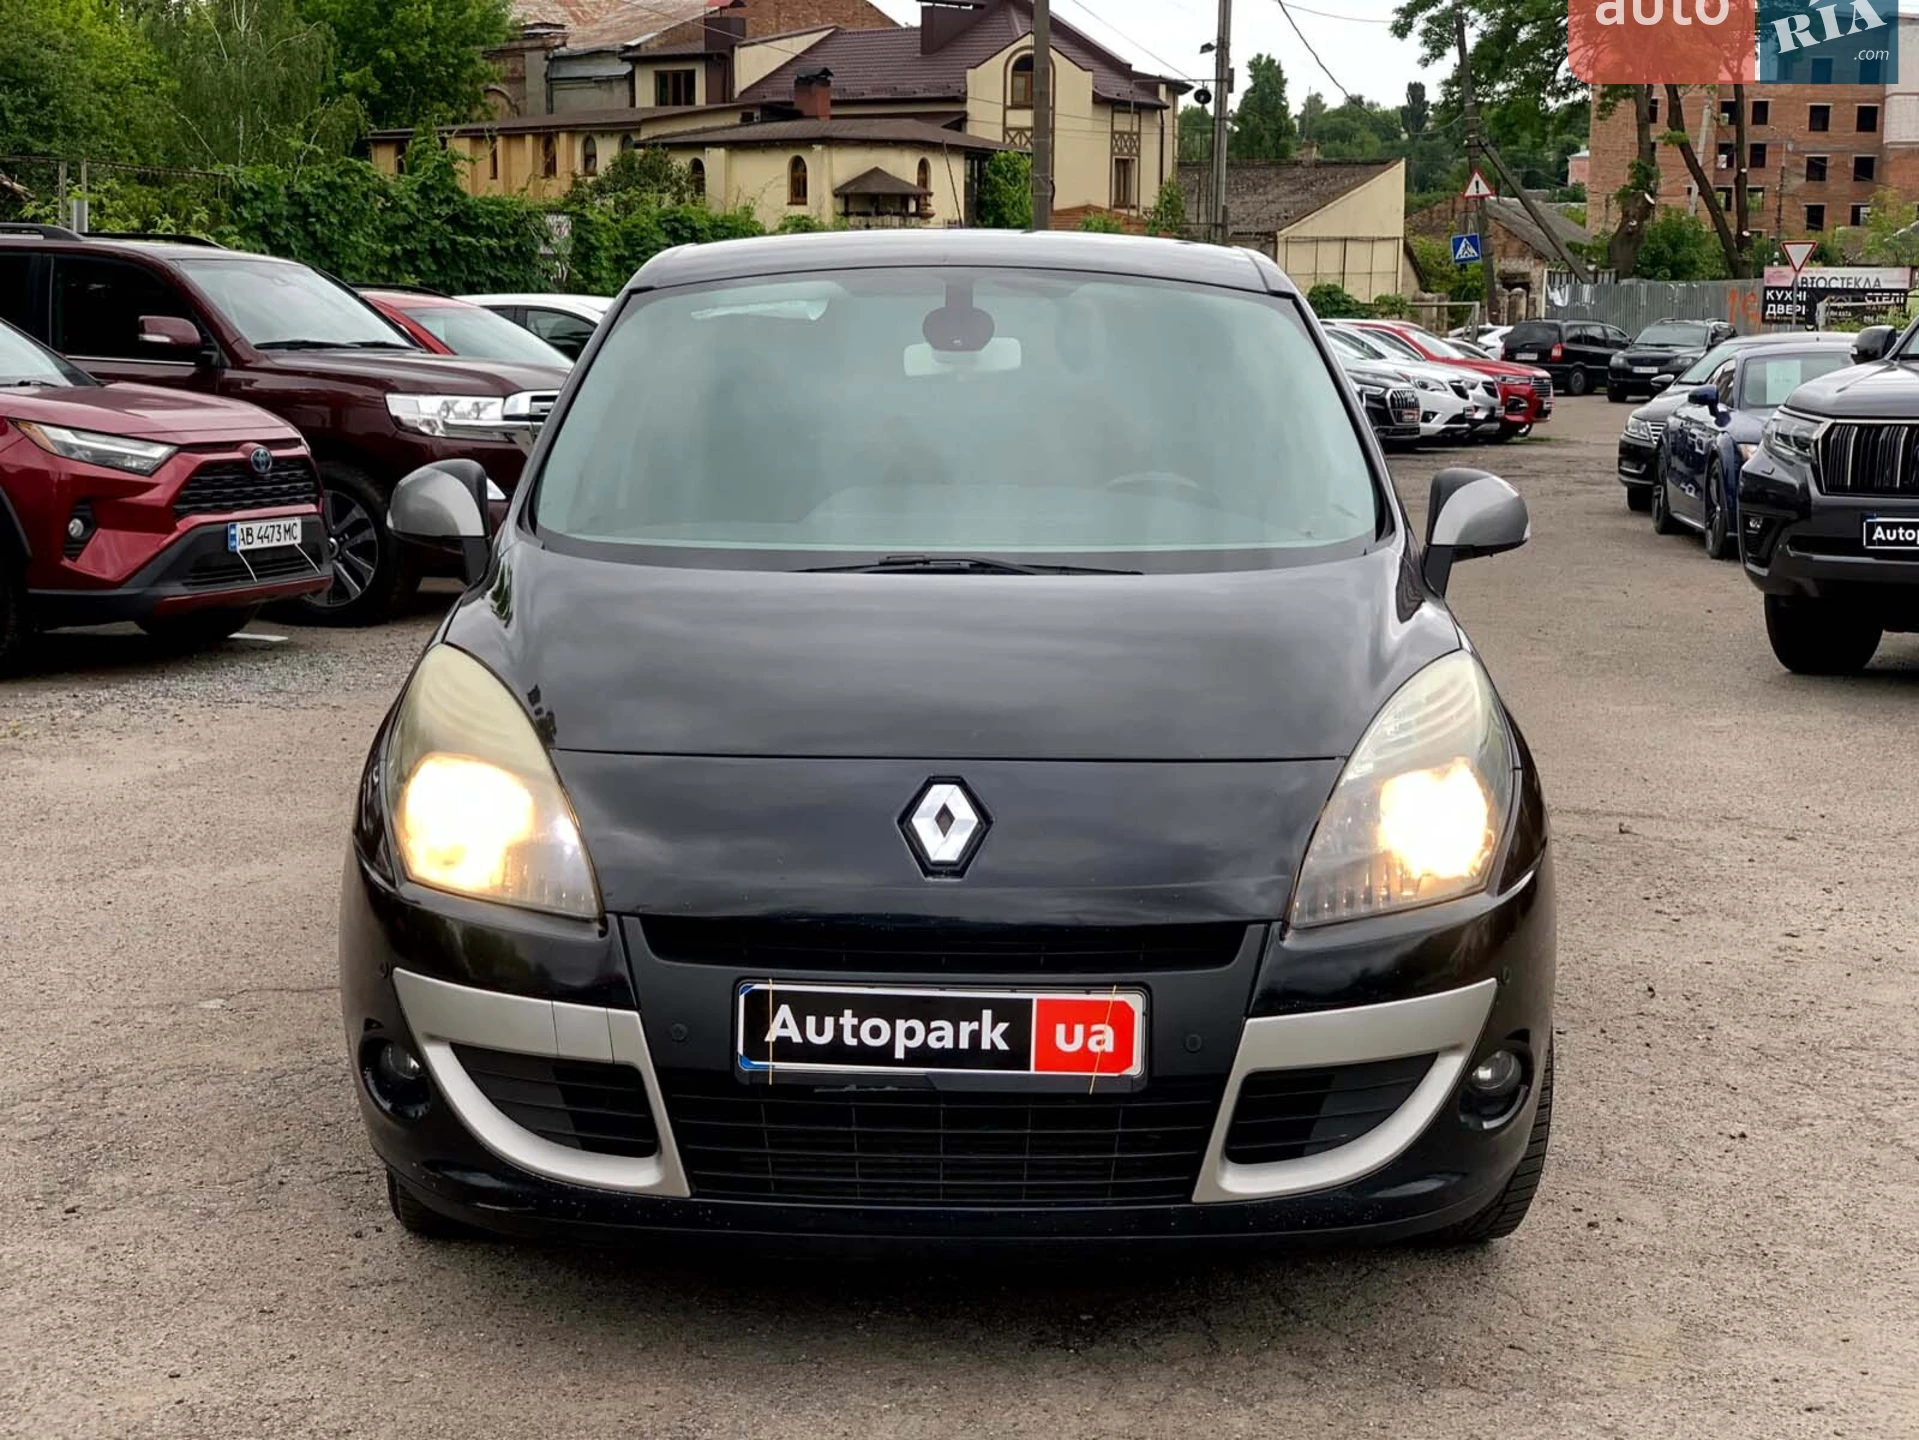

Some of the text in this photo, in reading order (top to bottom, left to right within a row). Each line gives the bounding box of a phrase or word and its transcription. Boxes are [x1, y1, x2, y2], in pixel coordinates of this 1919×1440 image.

[239, 527, 254, 546] AB
[257, 524, 282, 544] 4473
[284, 522, 298, 541] MC
[764, 1003, 1115, 1060] Autopark ua
